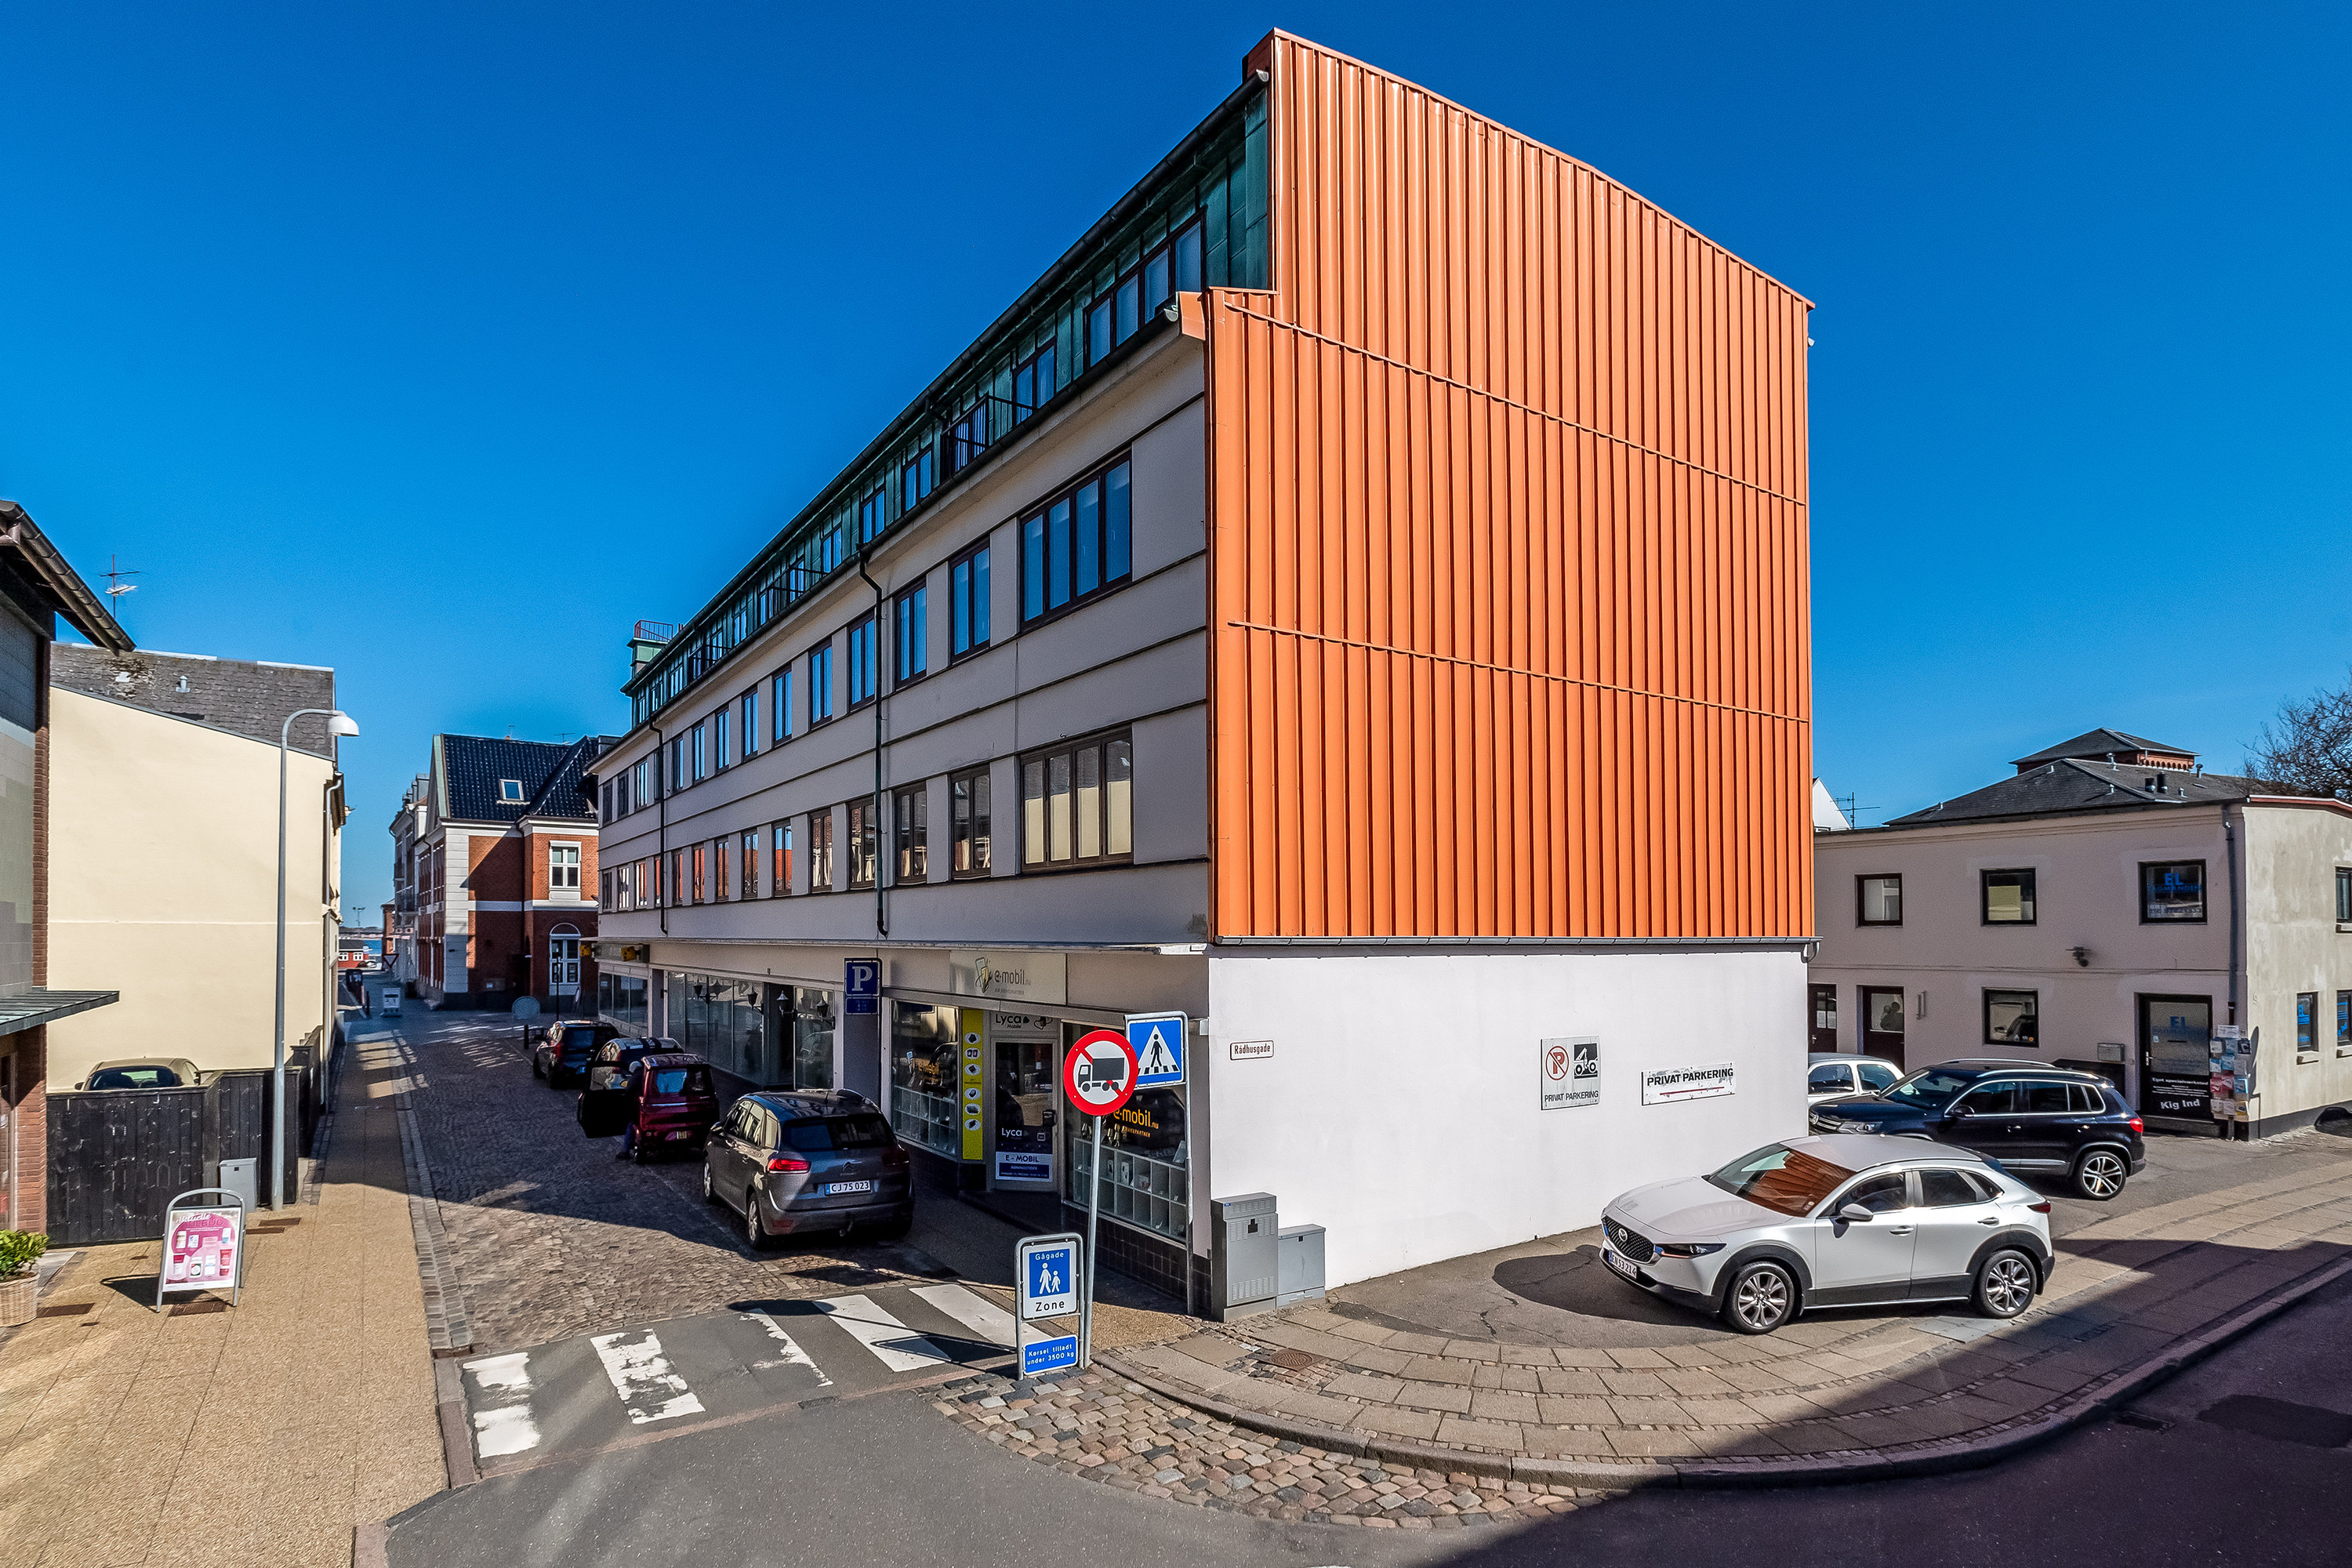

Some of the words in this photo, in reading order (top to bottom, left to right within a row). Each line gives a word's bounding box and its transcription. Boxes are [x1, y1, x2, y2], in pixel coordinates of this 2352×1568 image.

[851, 966, 873, 991] P
[995, 1013, 1022, 1025] Lyca
[1234, 1044, 1270, 1054] Rådhusgade
[1647, 1073, 1681, 1087] PRIVAT
[1682, 1068, 1733, 1082] PARKERING
[1544, 1094, 1565, 1102] PRIVAT
[1566, 1091, 1599, 1101] PARKERING
[2161, 1101, 2180, 1109] Kig
[2182, 1099, 2201, 1108] Ind
[1001, 1127, 1022, 1138] Lyca
[855, 1181, 869, 1190] 023
[1035, 1251, 1064, 1261] Gågade
[1035, 1300, 1065, 1312] Zone
[1029, 1348, 1049, 1357] Kørsel
[1052, 1343, 1073, 1352] tilladt
[1047, 1352, 1065, 1361] 3500
